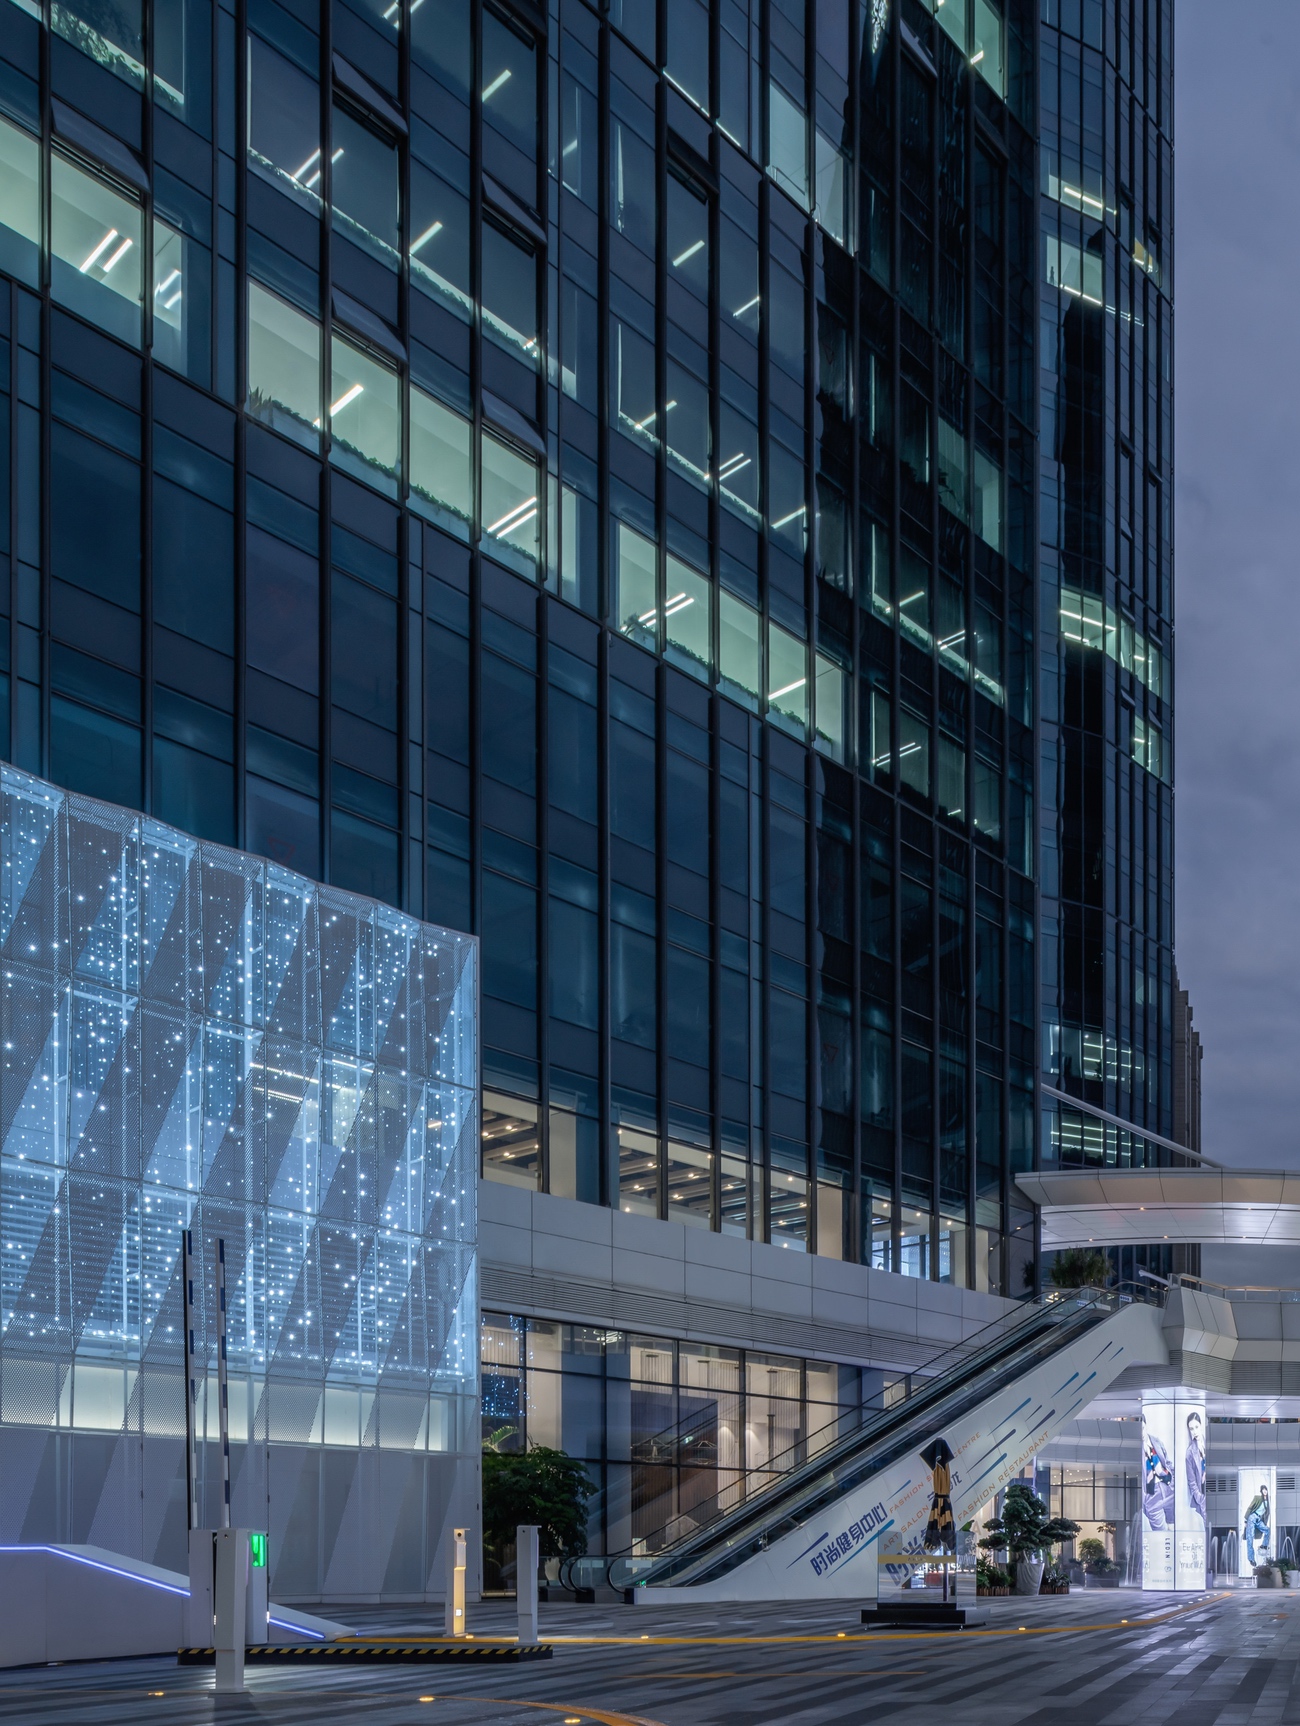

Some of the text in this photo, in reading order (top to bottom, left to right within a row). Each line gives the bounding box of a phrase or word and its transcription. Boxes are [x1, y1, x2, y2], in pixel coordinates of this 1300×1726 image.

[890, 1482, 924, 1514] FASHION
[957, 1483, 996, 1521] FASHION
[998, 1430, 1049, 1483] RESTAURANT
[810, 1501, 888, 1576] 时尚健身中心
[882, 1504, 930, 1552] ART SALON
